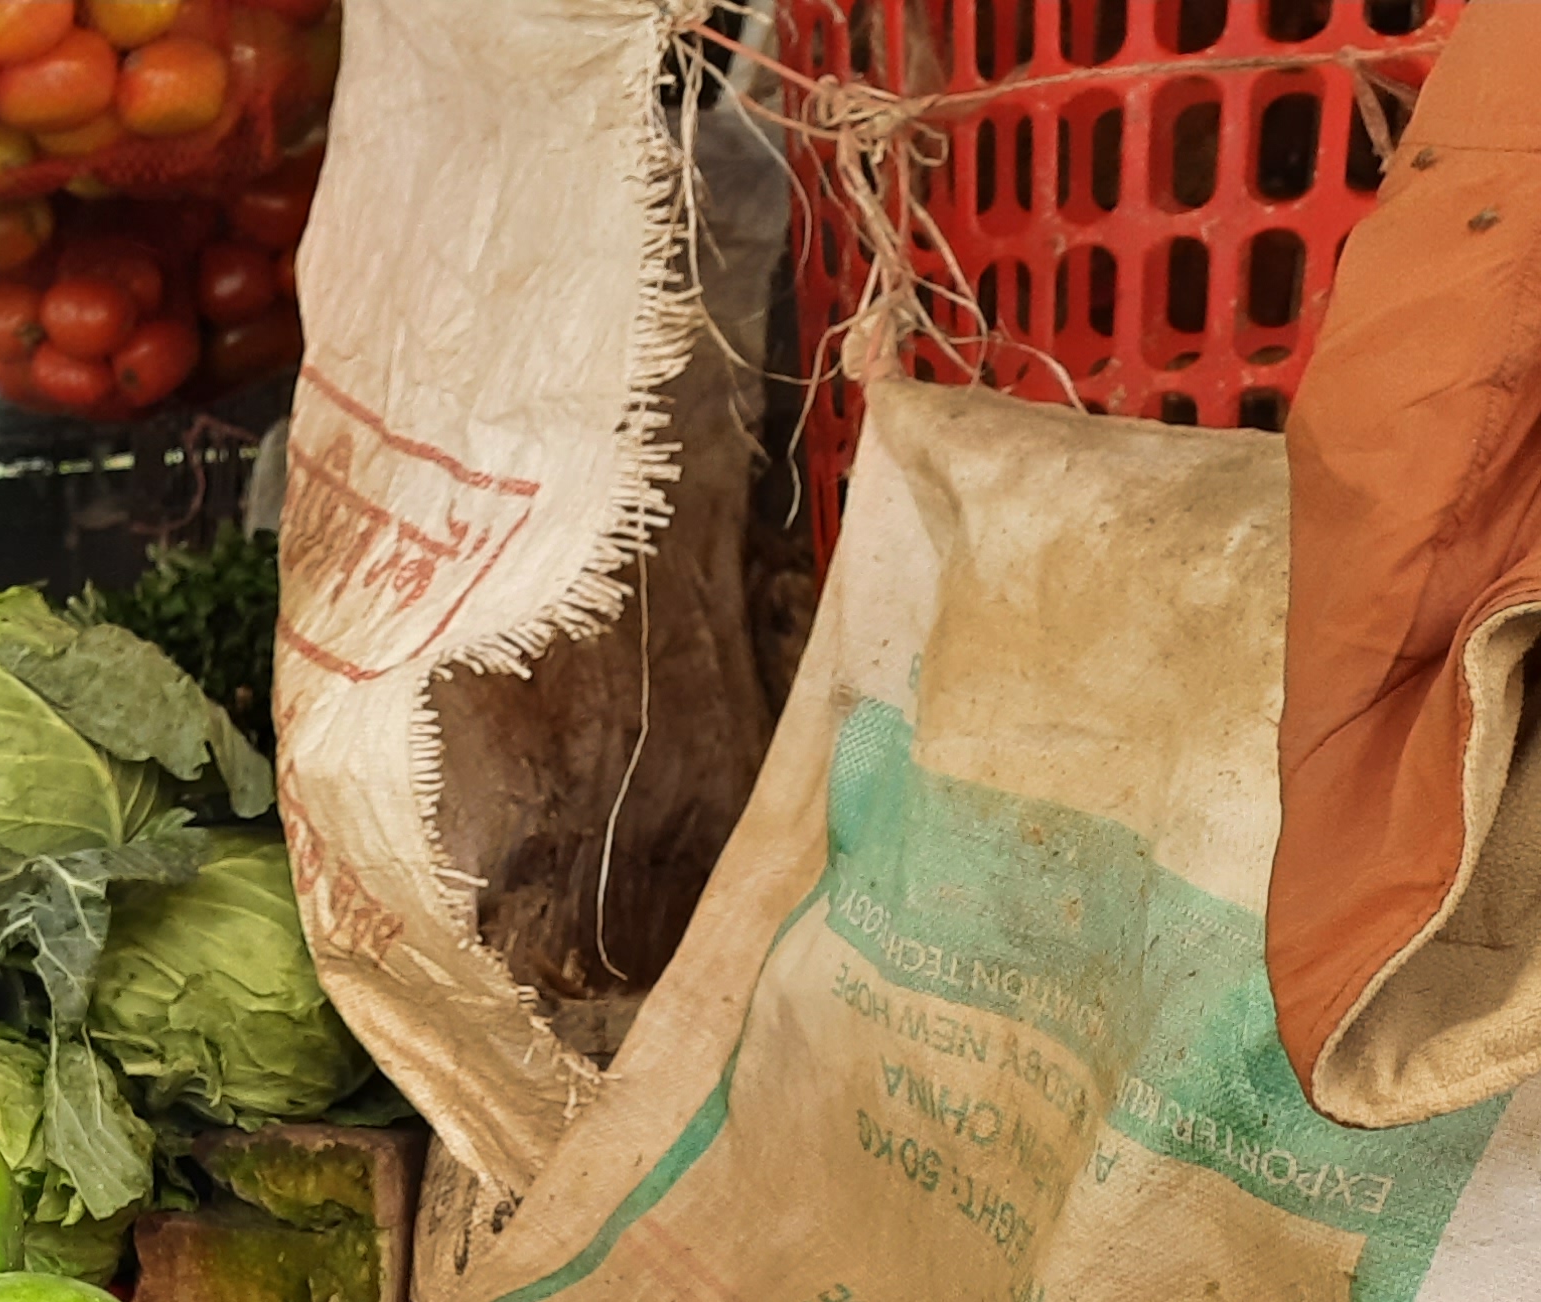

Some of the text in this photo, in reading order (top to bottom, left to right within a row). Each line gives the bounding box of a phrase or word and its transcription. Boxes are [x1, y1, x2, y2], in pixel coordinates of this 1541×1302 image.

[831, 961, 891, 1029] HOPE
[897, 1003, 992, 1064] NEW
[879, 1053, 1004, 1146] CHINA
